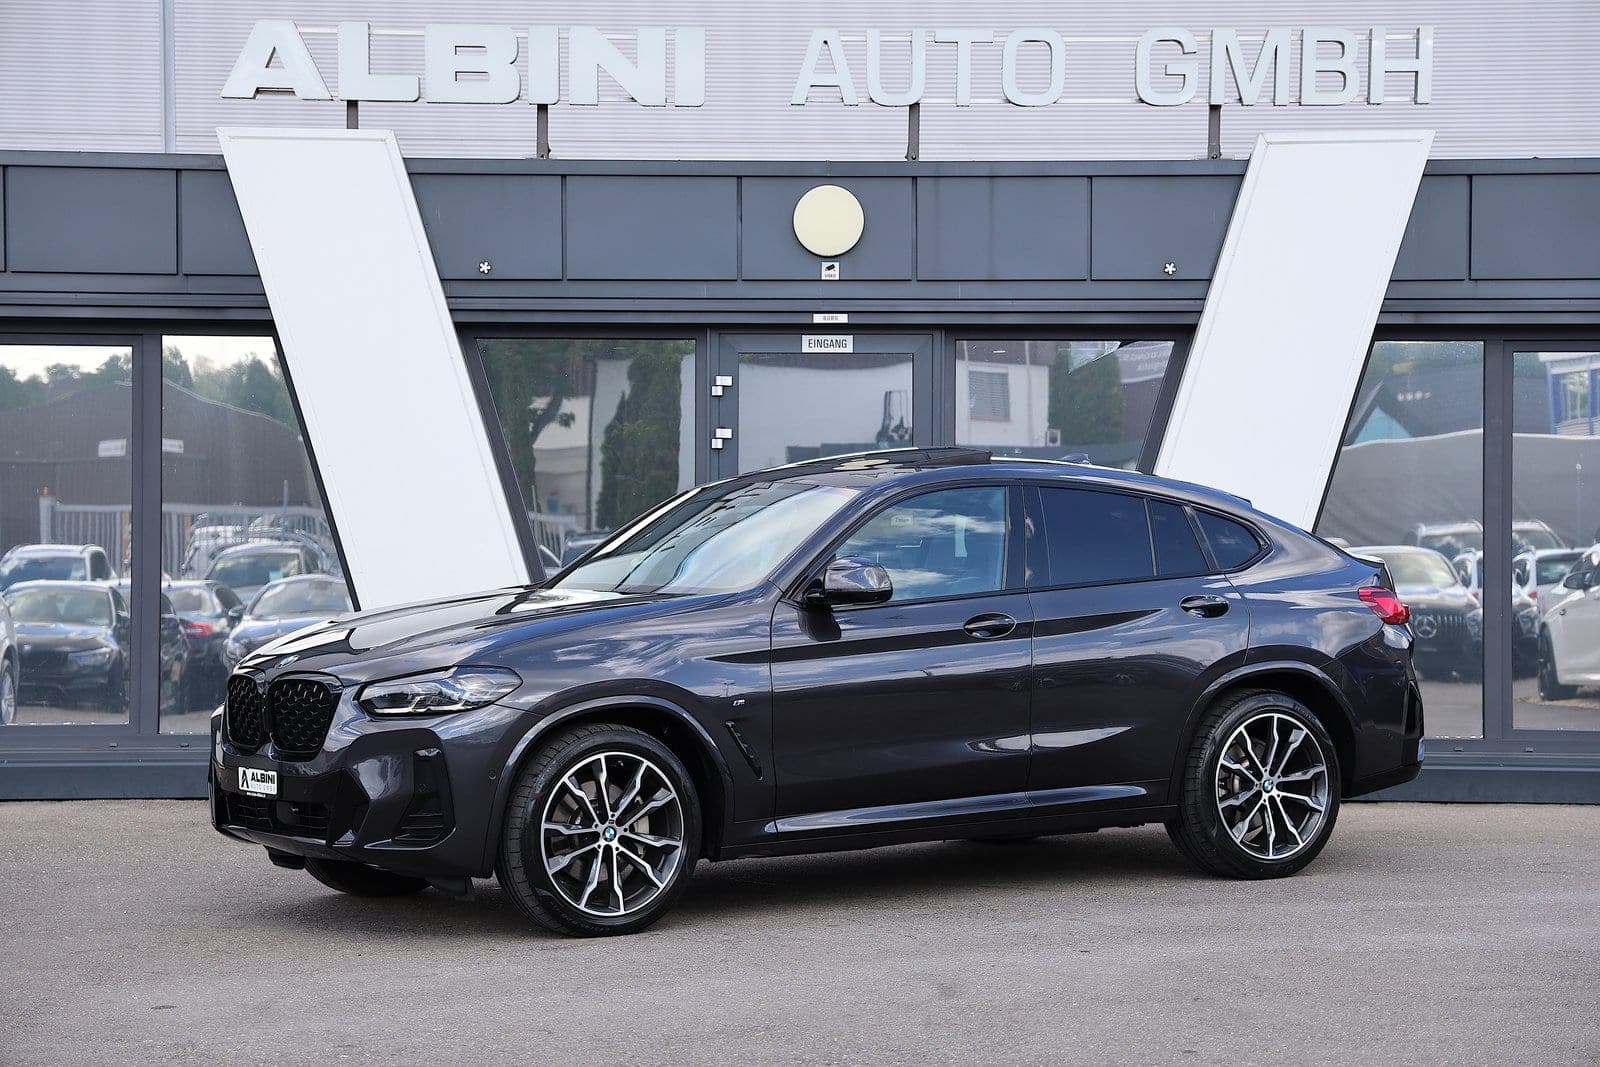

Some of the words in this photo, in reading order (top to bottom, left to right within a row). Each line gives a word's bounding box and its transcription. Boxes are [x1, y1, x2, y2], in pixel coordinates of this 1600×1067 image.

[220, 20, 706, 107] ALBINI
[790, 28, 1067, 107] AUTO
[1134, 25, 1435, 107] GMBH
[808, 338, 847, 349] EINGANG
[251, 772, 275, 784] ALBINI
